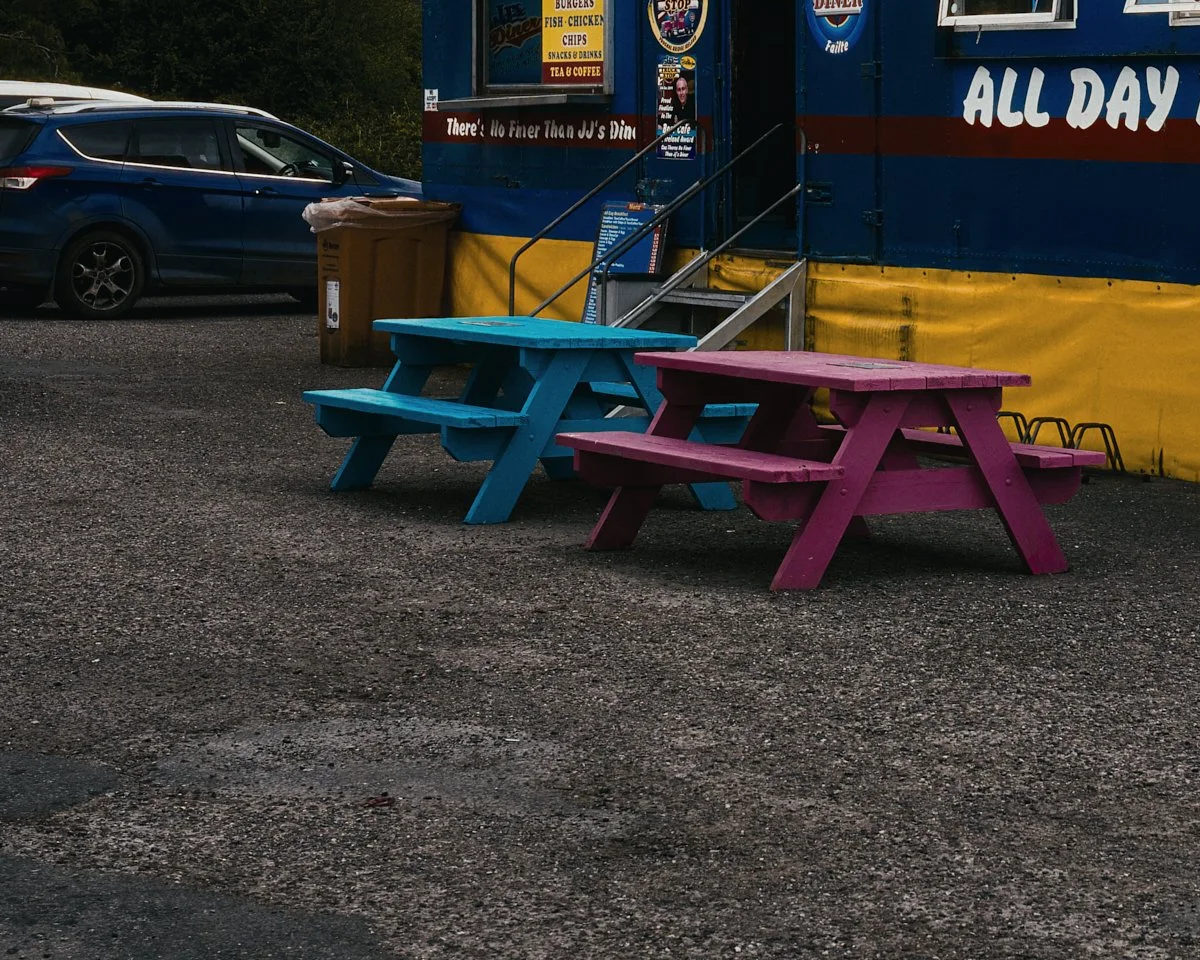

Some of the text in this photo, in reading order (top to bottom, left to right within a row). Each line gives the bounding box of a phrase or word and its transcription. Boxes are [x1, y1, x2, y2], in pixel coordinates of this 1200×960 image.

[664, 0, 691, 11] STOP
[544, 16, 563, 28] FISH
[562, 34, 587, 46] CHIPS
[548, 51, 572, 60] SNACKS
[578, 50, 602, 59] DRINKS
[550, 67, 565, 77] TEA
[572, 66, 601, 77] COFFEE
[962, 64, 1050, 128] ALL
[1065, 63, 1181, 133] DAY
[490, 119, 505, 139] No
[508, 120, 540, 139] Finer
[544, 119, 574, 139] Than
[577, 120, 606, 140] JJ's
